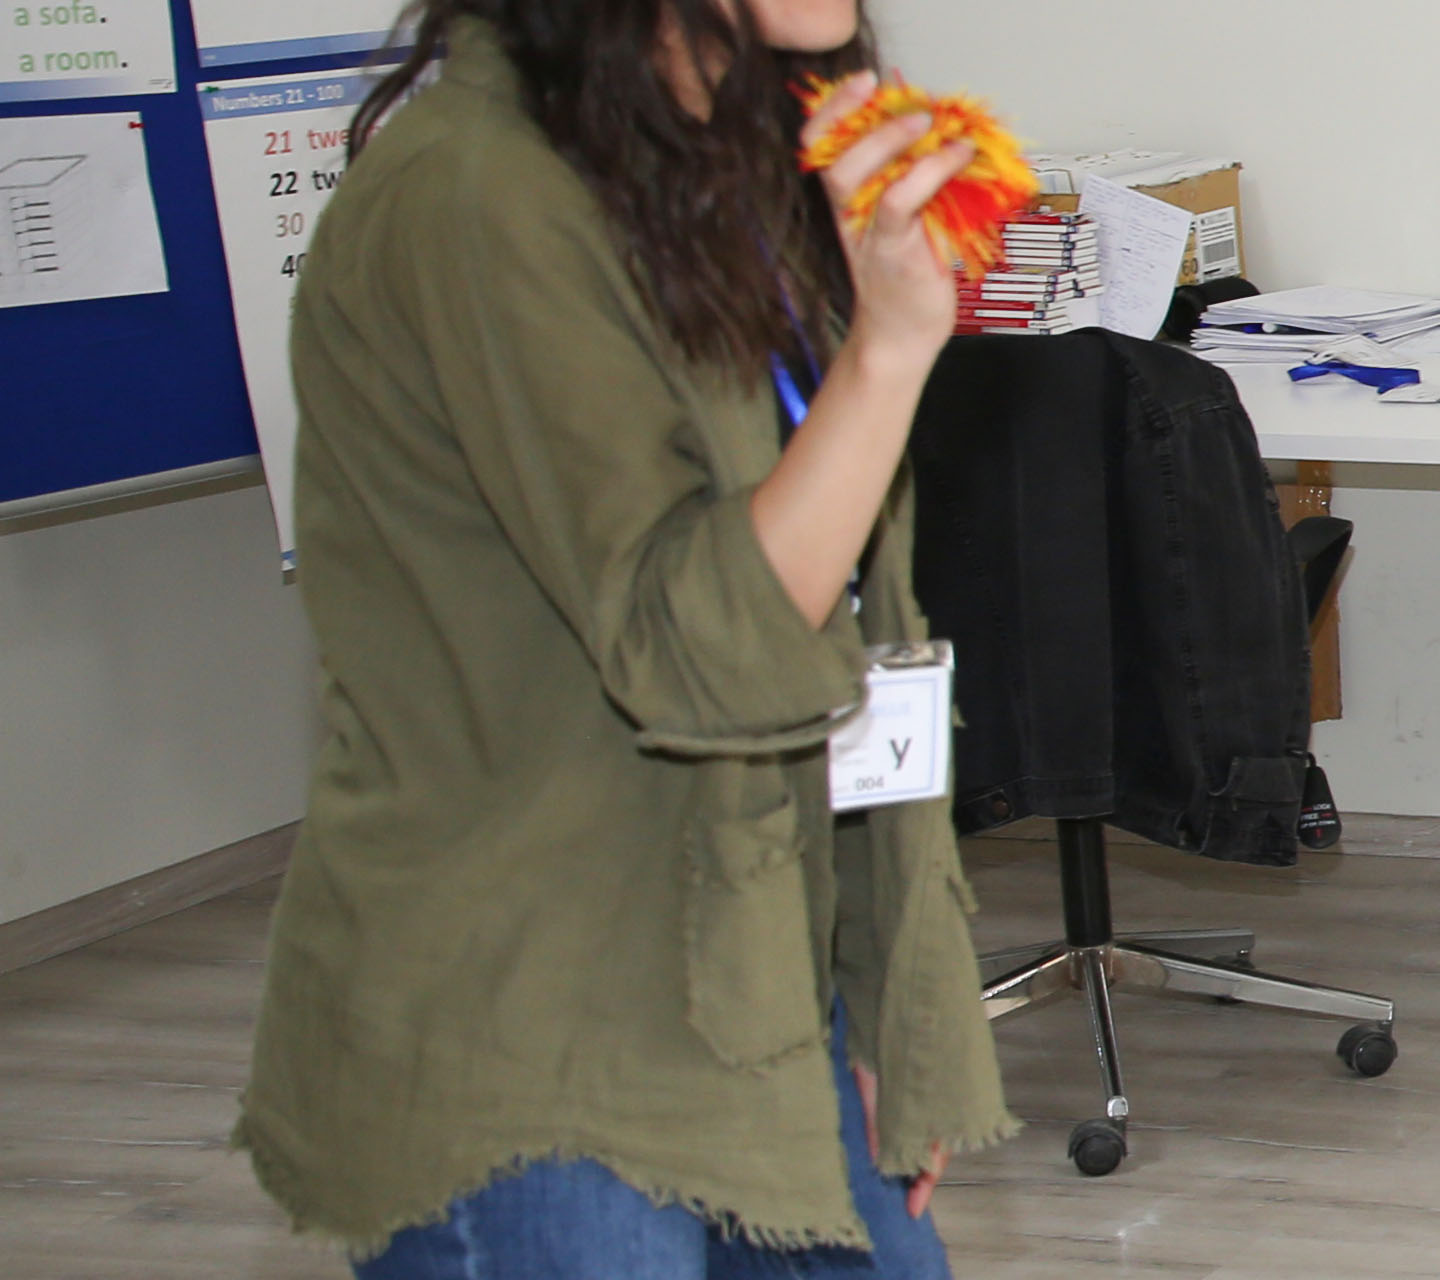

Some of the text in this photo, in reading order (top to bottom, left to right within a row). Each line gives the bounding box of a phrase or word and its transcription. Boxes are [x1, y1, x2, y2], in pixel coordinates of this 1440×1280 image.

[14, 7, 30, 26] a
[19, 50, 128, 72] a room.
[212, 84, 344, 113] Numbers 21 100
[264, 130, 293, 156] 21
[269, 171, 299, 197] 22
[275, 212, 304, 238] 30
